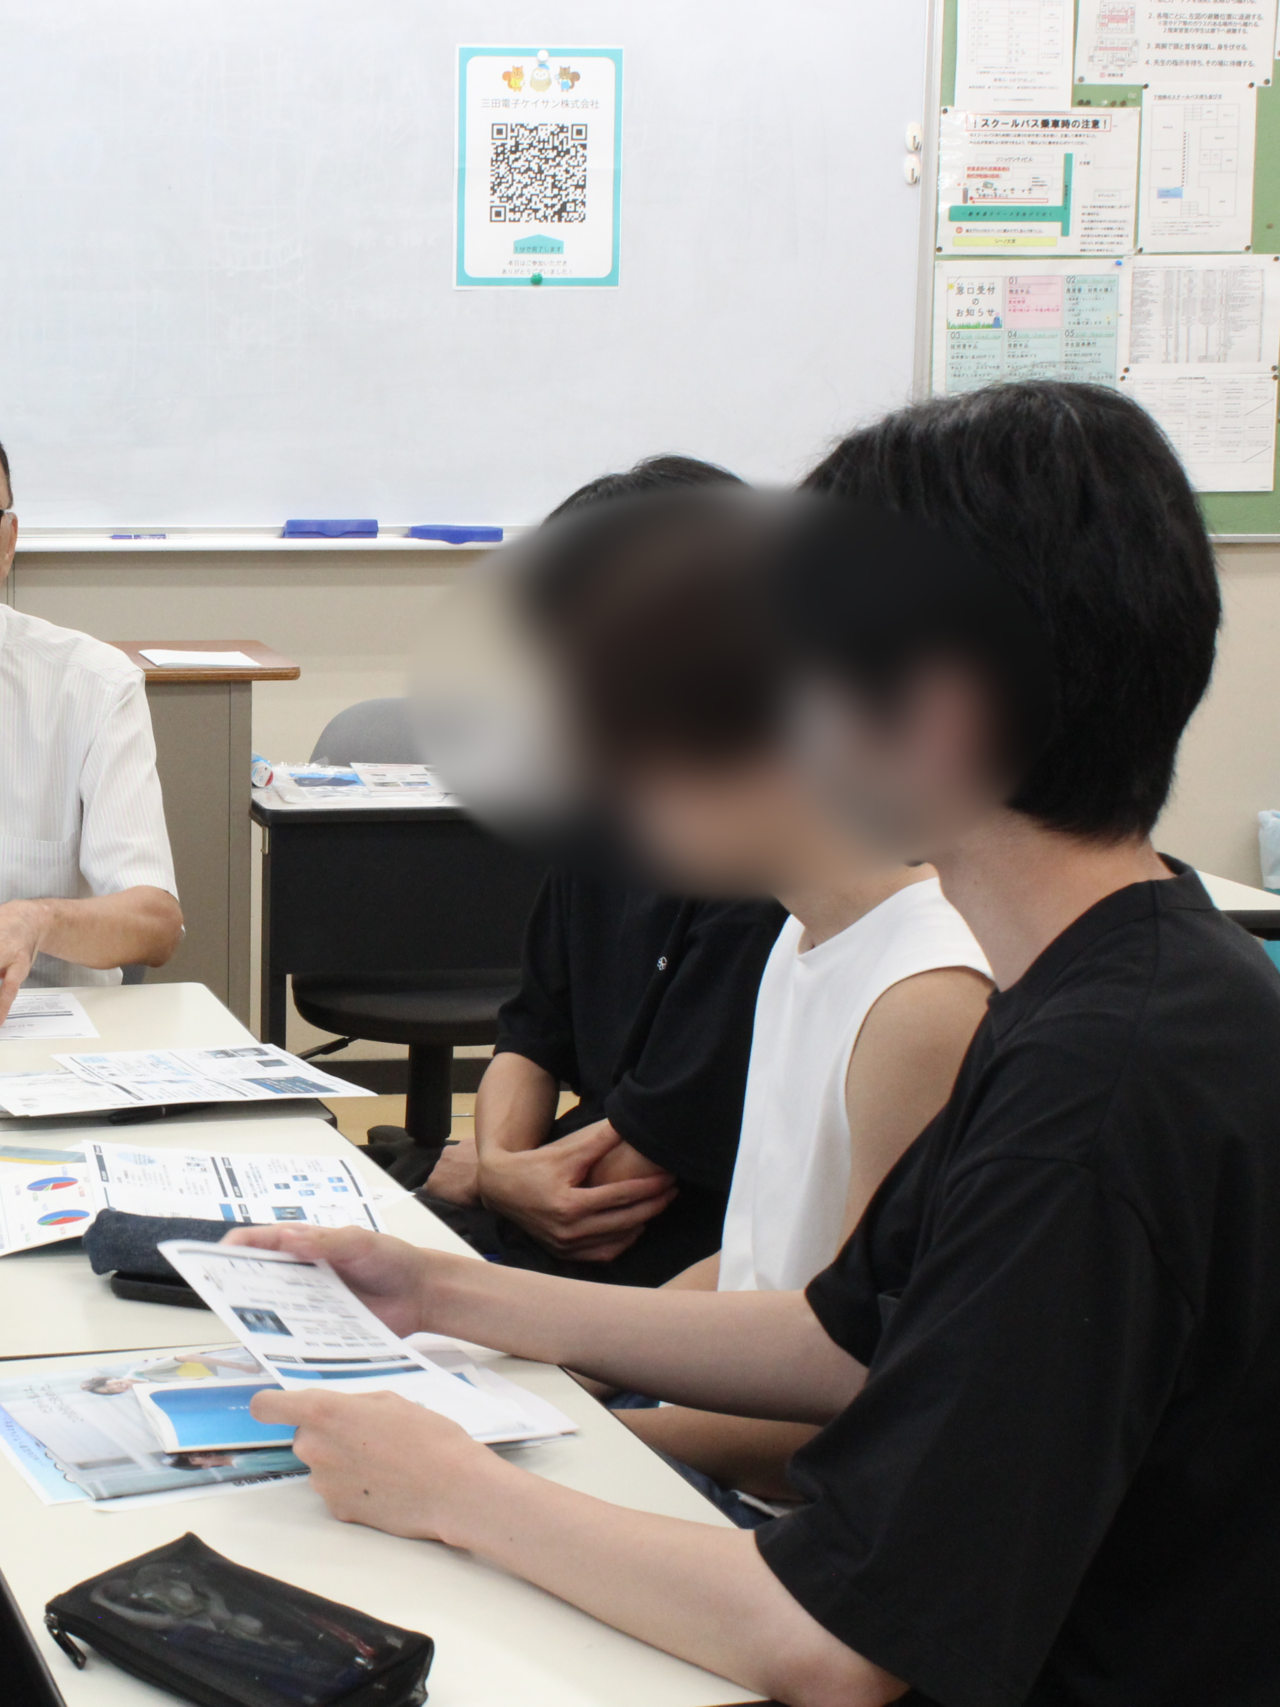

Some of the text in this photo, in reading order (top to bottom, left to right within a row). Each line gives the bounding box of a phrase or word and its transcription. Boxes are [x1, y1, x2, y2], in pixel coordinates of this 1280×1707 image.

[481, 98, 600, 110] 三田電子ケイサン株式会社
[1008, 276, 1018, 284] 01
[1066, 276, 1076, 284] 02
[955, 286, 996, 296] 窓口受付
[971, 298, 980, 306] の
[956, 308, 996, 317] お知らせ
